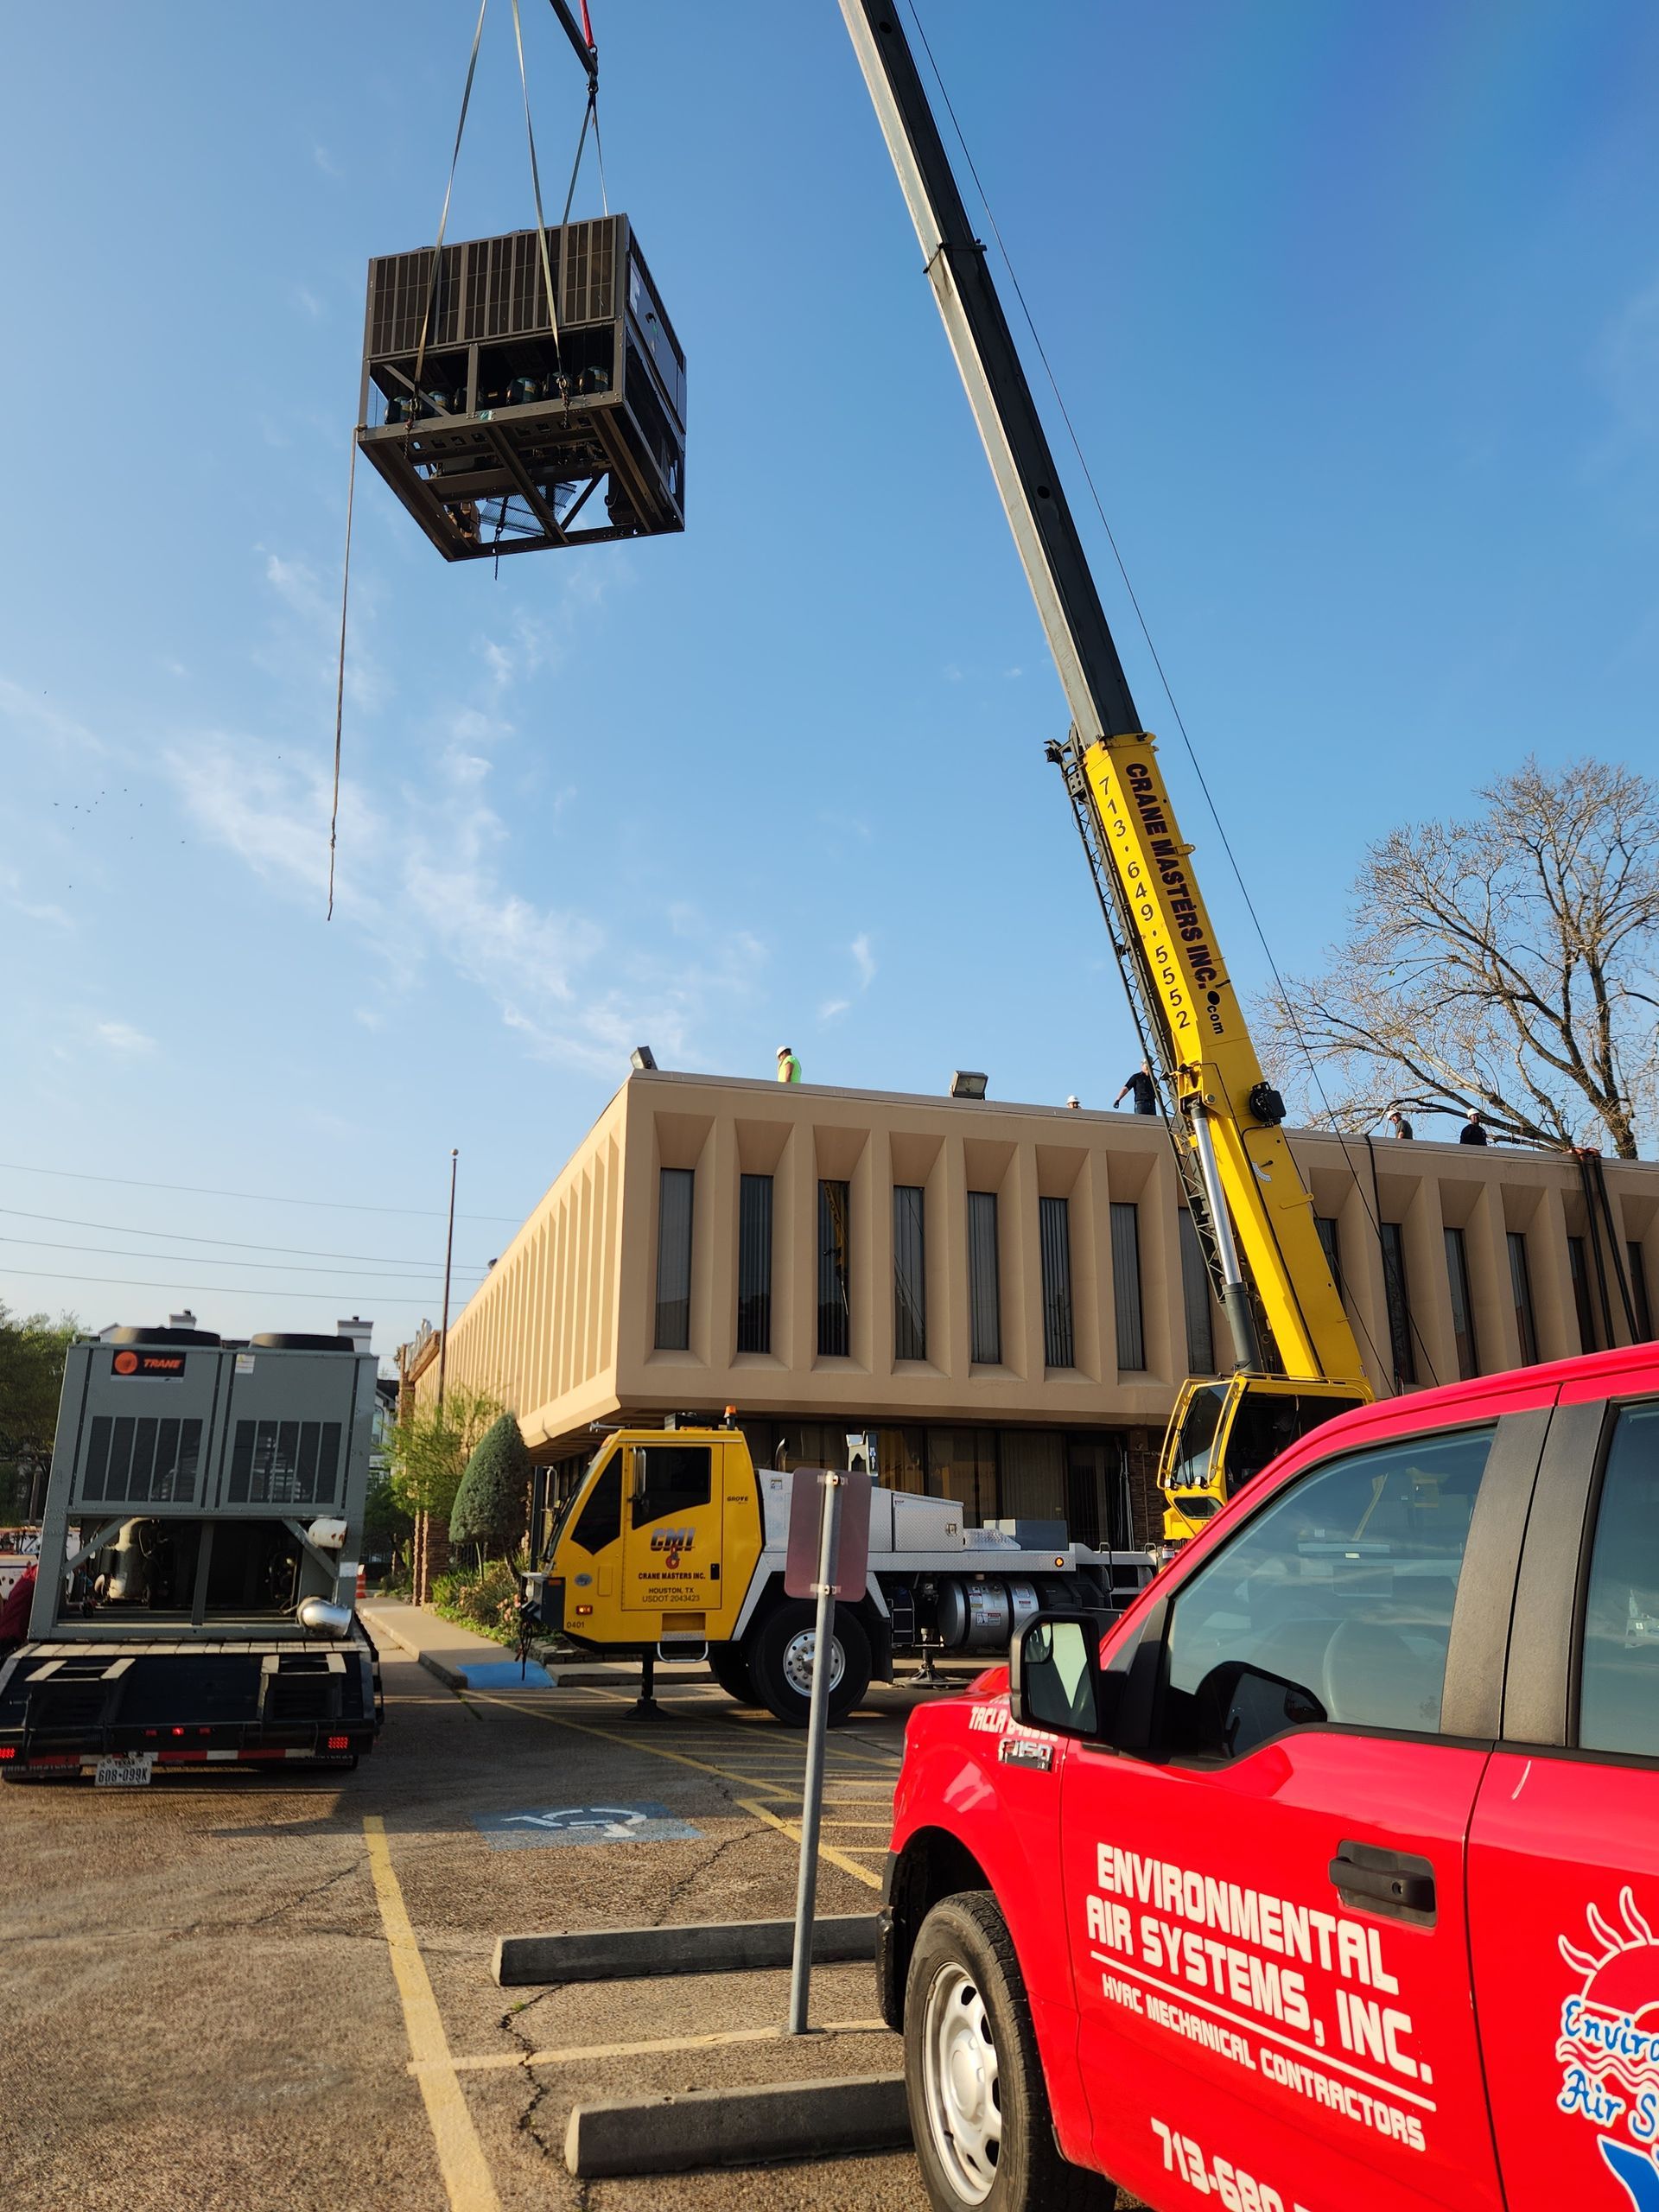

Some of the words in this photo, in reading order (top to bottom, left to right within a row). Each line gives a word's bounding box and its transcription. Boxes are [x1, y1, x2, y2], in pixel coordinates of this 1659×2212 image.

[1126, 763, 1169, 836] CRANE
[1150, 839, 1204, 942] MASTERS
[1186, 944, 1217, 989] INC.
[143, 1358, 182, 1369] TRANE
[651, 1528, 696, 1552] CMI
[969, 1706, 1008, 1733] TACLA
[1096, 1841, 1400, 1995] ENVIRONMENTAL
[1086, 1894, 1134, 1956] AIR
[1140, 1915, 1325, 2047] SYSTEMS,
[1336, 1988, 1433, 2084] INC.
[1102, 1973, 1143, 2015] HVAC
[1145, 1993, 1256, 2070] MECHANICAL
[1260, 2047, 1427, 2152] CONTRACTORS
[1560, 2069, 1622, 2120] Air
